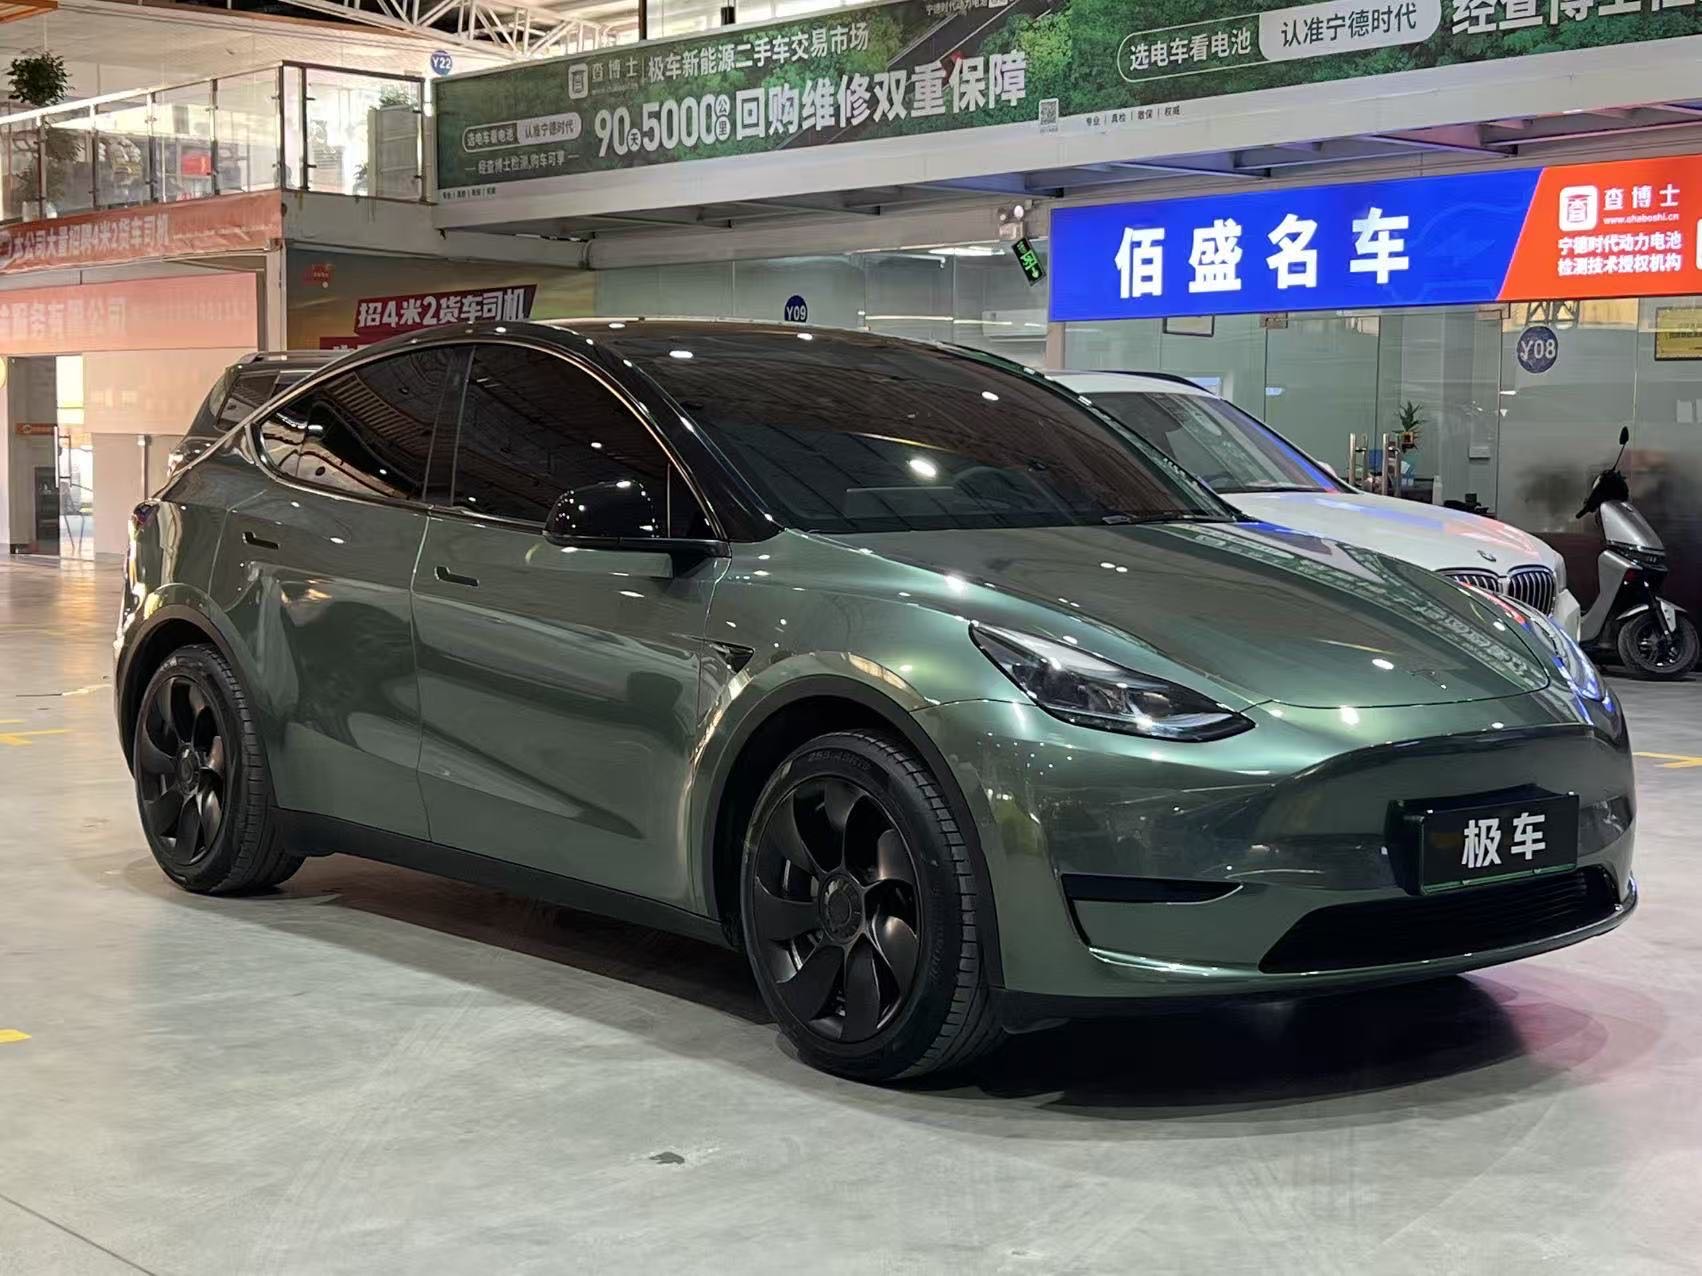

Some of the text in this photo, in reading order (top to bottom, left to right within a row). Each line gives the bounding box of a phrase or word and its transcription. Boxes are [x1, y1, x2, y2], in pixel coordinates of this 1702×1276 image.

[1280, 3, 1417, 48] 认准宁德时代
[430, 56, 452, 70] Y22
[648, 22, 870, 84] 极车新能源二手车交易市场
[1129, 29, 1251, 71] 选电车看电池
[591, 56, 639, 83] 查博士
[1604, 184, 1680, 210] 查博士
[1114, 206, 1411, 300] 佰盛名车
[1558, 230, 1682, 255] 宁德时代动力电池
[358, 288, 528, 328] 招4米2货车司机
[786, 305, 807, 321] Y09
[1520, 339, 1556, 361] Y08
[1461, 811, 1547, 868] 极车
